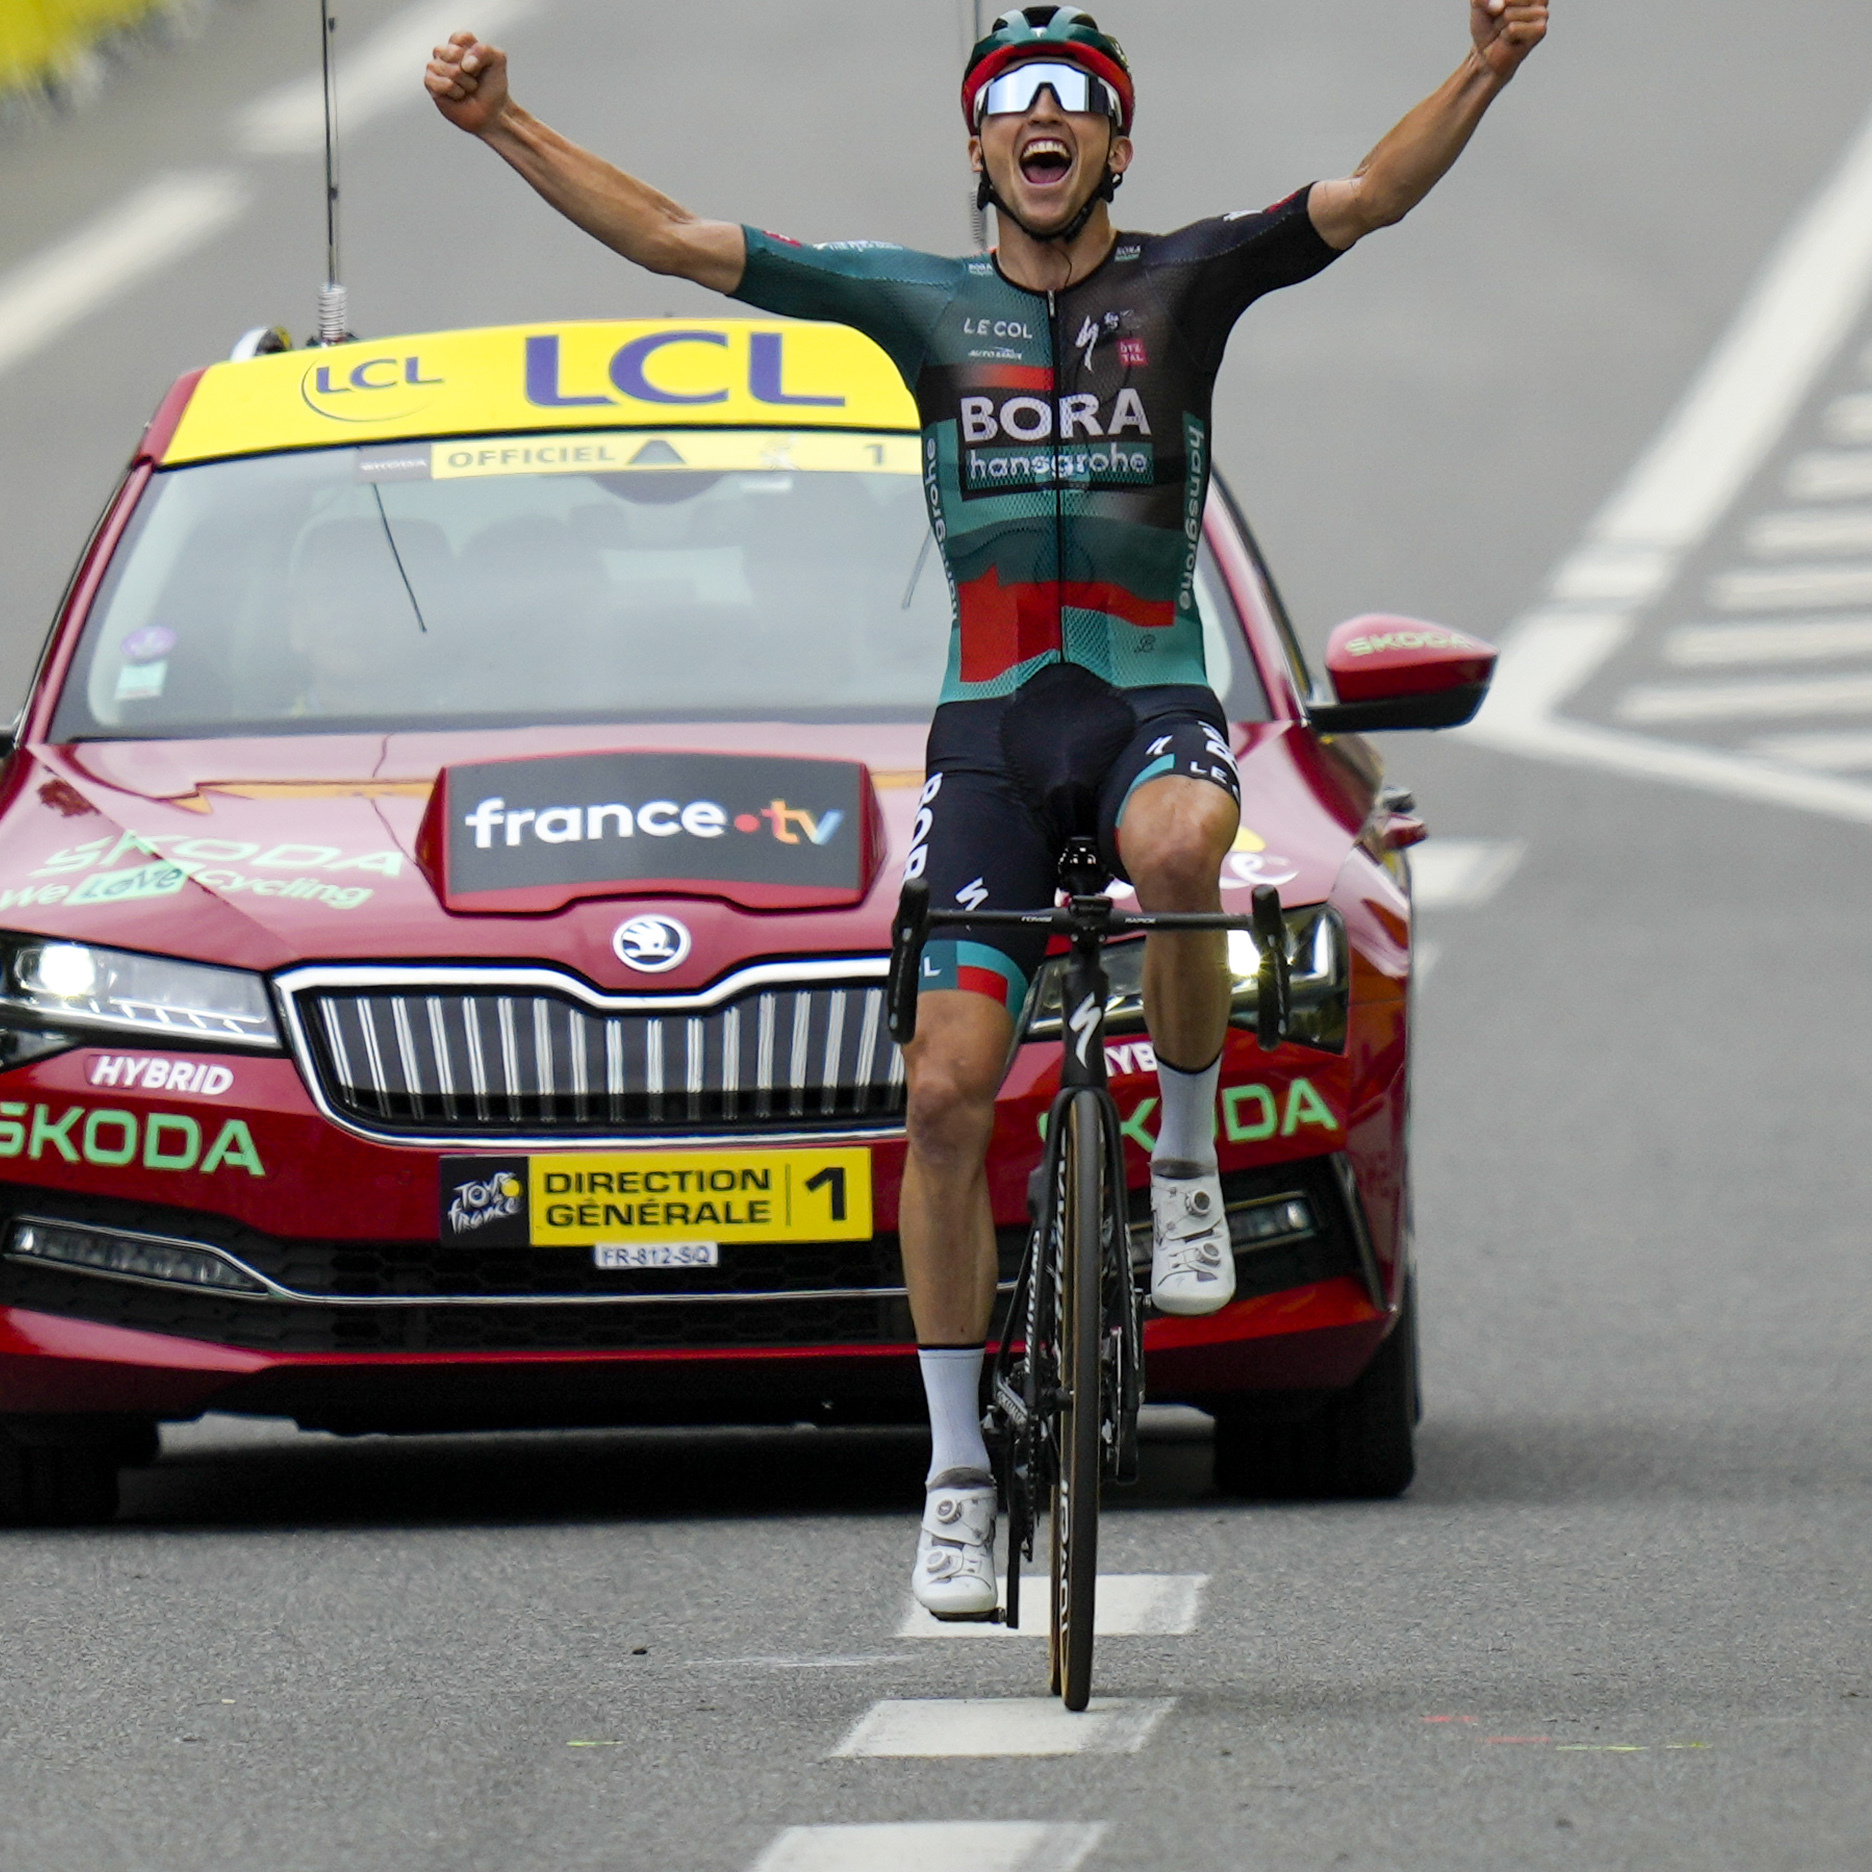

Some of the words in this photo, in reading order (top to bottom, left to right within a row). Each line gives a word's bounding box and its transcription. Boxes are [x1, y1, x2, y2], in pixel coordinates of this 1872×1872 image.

[963, 317, 991, 336] LE
[993, 320, 1033, 339] COL
[314, 356, 444, 395] LCL
[524, 330, 846, 408] LCL
[961, 388, 1151, 442] BORA
[447, 445, 616, 469] OFFICIEL
[864, 443, 885, 466] 1
[969, 442, 1149, 481] hansgrohe
[87, 1054, 235, 1096] HYBRID
[1037, 1077, 1338, 1152] KDA
[545, 1169, 771, 1195] DIRECTION
[804, 1166, 847, 1222] 1
[546, 1197, 772, 1227] GÉNÉRALE
